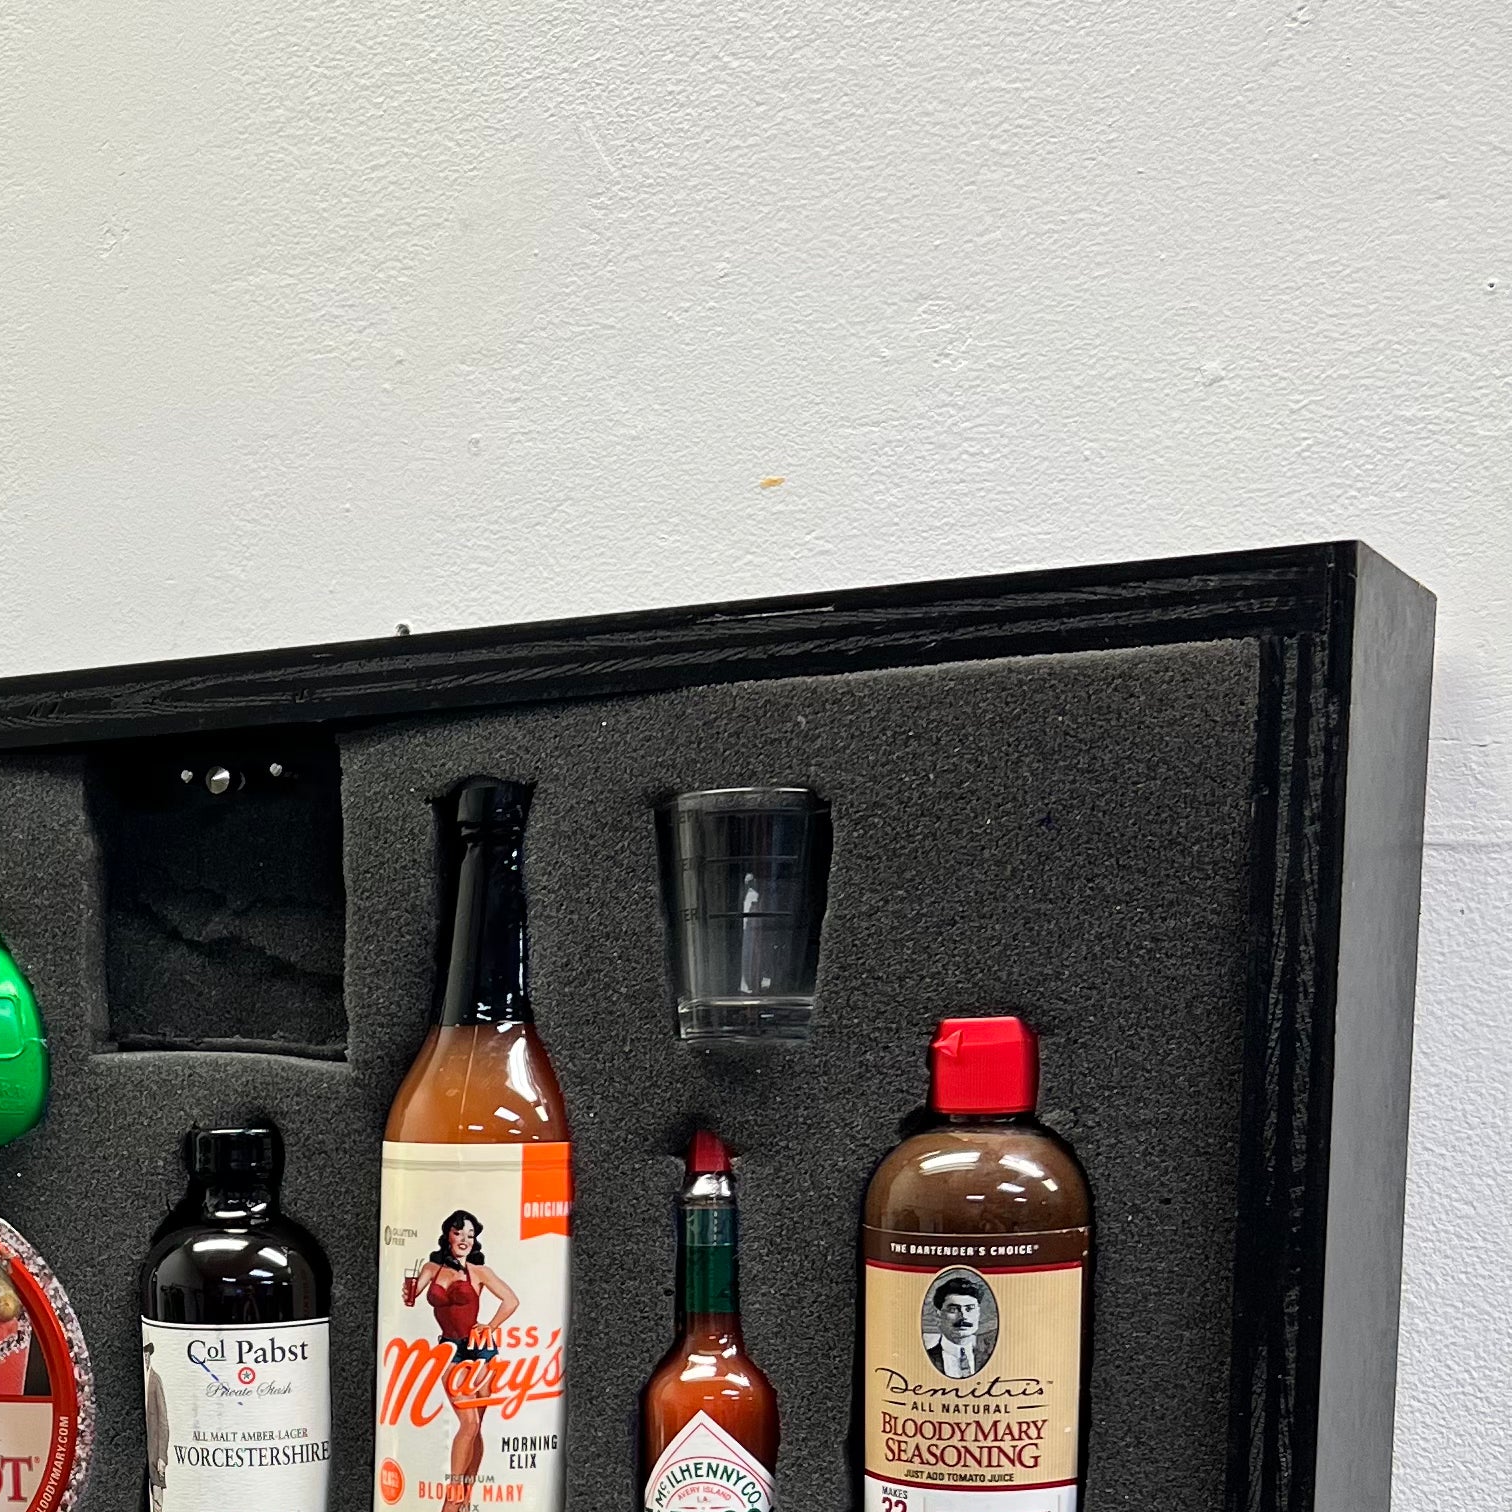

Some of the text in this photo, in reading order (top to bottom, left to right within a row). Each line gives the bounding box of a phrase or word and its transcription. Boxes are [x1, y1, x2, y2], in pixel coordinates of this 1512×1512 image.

[523, 1201, 572, 1219] ORIGINA
[890, 1242, 907, 1253] THE
[910, 1244, 986, 1256] BARTENDER'S
[468, 1326, 539, 1350] MISS
[188, 1336, 308, 1365] Col Pabst
[206, 1379, 292, 1398] Private Stash
[912, 1401, 1011, 1415] ALL NATURAL
[193, 1427, 308, 1442] ALL MALT AMBER LAGER
[502, 1435, 558, 1452] MORNING
[174, 1440, 332, 1468] WORCESTERSHIRE
[885, 1437, 1042, 1469] SEASONING
[445, 1474, 495, 1484] PREMIUM
[904, 1469, 1015, 1482] JUST ADD TOMATO JUICE
[418, 1481, 524, 1502] BLOODY MARY
[677, 1485, 732, 1501] AVERY ISLAND
[881, 1485, 908, 1499] MAKES
